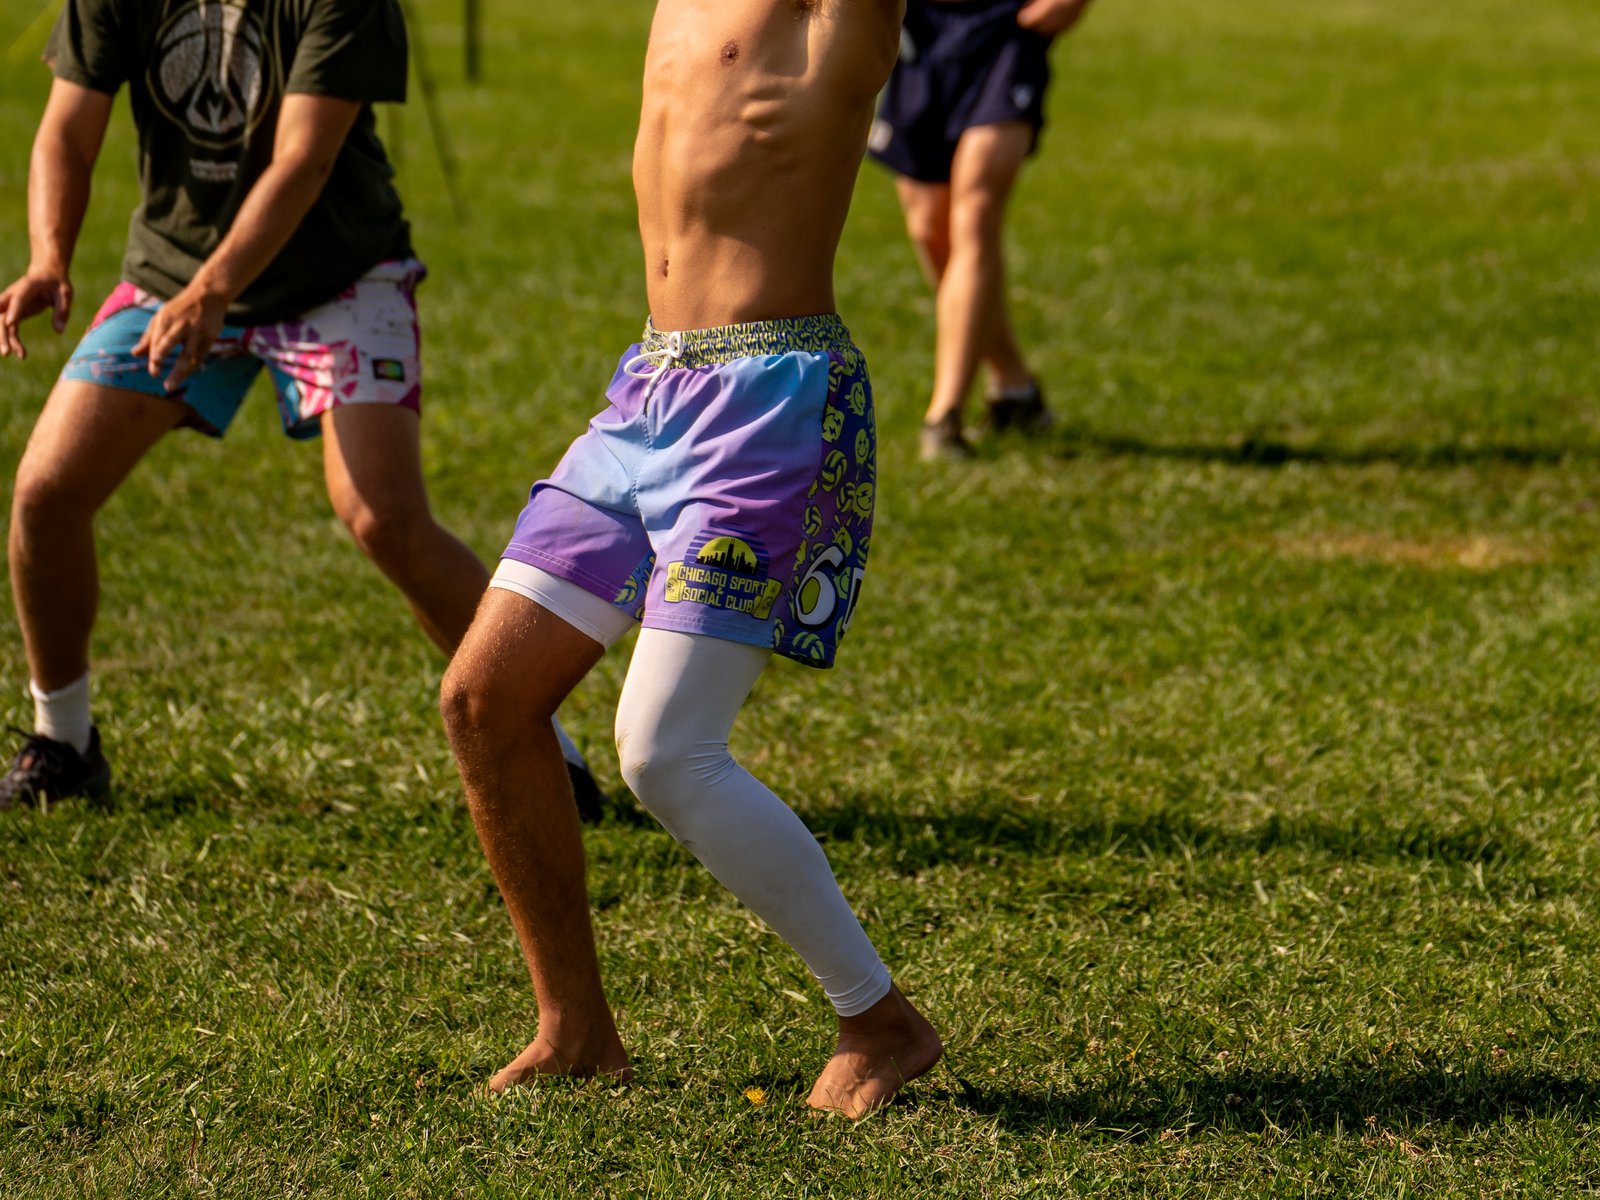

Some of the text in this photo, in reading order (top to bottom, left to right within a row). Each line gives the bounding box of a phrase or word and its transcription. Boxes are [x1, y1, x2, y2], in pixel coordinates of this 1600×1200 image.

[678, 566, 768, 595] CHICAGO SPORT
[716, 587, 724, 595] &
[682, 586, 754, 613] SOCIAL CLUB
